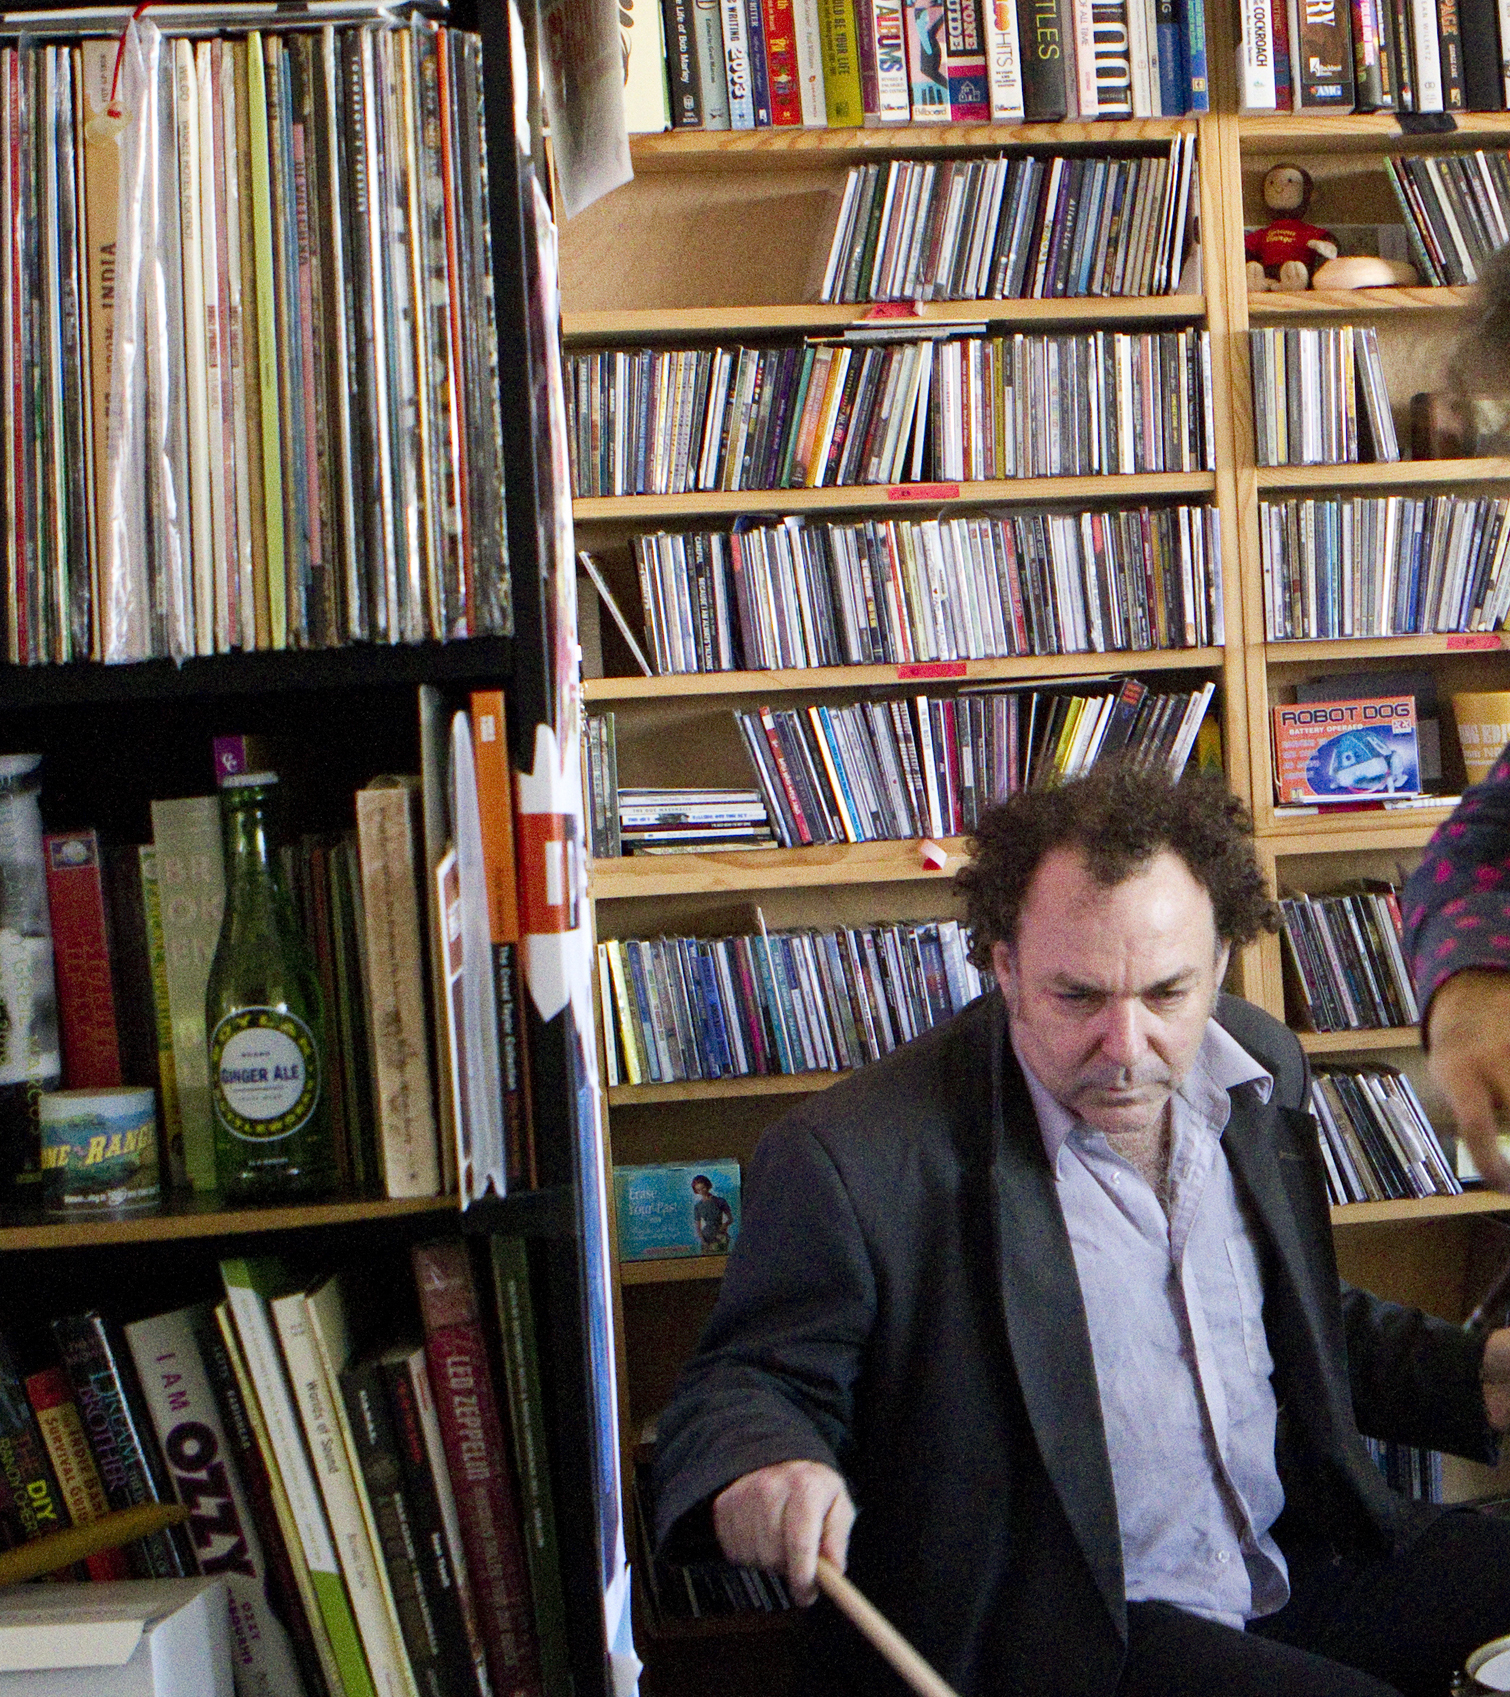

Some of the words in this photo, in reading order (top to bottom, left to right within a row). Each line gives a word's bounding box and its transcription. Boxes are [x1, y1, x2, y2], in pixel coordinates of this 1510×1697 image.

[676, 6, 686, 22] Life
[678, 24, 686, 33] of
[727, 7, 741, 42] WRITING
[835, 18, 846, 29] BE
[1035, 2, 1061, 60] TLES
[1079, 10, 1090, 23] ALL
[679, 35, 689, 52] Bob
[836, 32, 848, 54] YOUR
[876, 5, 903, 73] ALBUMS
[994, 32, 1013, 68] HITS
[1081, 27, 1091, 46] TIME
[1253, 7, 1268, 67] COCKROACH
[178, 63, 190, 102] WILCO
[680, 54, 690, 84] Marley
[728, 48, 748, 99] 2003
[838, 57, 850, 76] LIFE
[1316, 86, 1342, 97] AMG
[915, 105, 947, 116] Billboard
[179, 118, 191, 157] YANKEE
[181, 159, 192, 193] HOTEL
[100, 242, 117, 309] INDIA
[695, 536, 703, 564] CAREFUL
[697, 577, 706, 606] BECAUSE
[1282, 706, 1358, 726] ROBOT
[1363, 702, 1410, 720] DOG
[1289, 726, 1325, 736] BATTERY
[499, 946, 511, 966] The
[499, 967, 512, 1001] Creed
[221, 1066, 268, 1085] GINGER
[274, 1063, 300, 1081] ALE
[155, 1352, 176, 1363] I
[446, 1355, 476, 1391] LED
[160, 1372, 191, 1412] AM
[305, 1381, 326, 1424] Worlds
[90, 1370, 137, 1467] DREAM
[317, 1421, 331, 1436] of
[79, 1386, 127, 1494] BROTHER
[454, 1395, 491, 1482] ZEPPELIN
[46, 1416, 78, 1485] SURVIVAL
[68, 1485, 92, 1527] GUID
[320, 1438, 339, 1475] Sound
[12, 1490, 40, 1535] CHER
[27, 1479, 57, 1522] DIY
[163, 1420, 258, 1580] OZZY
